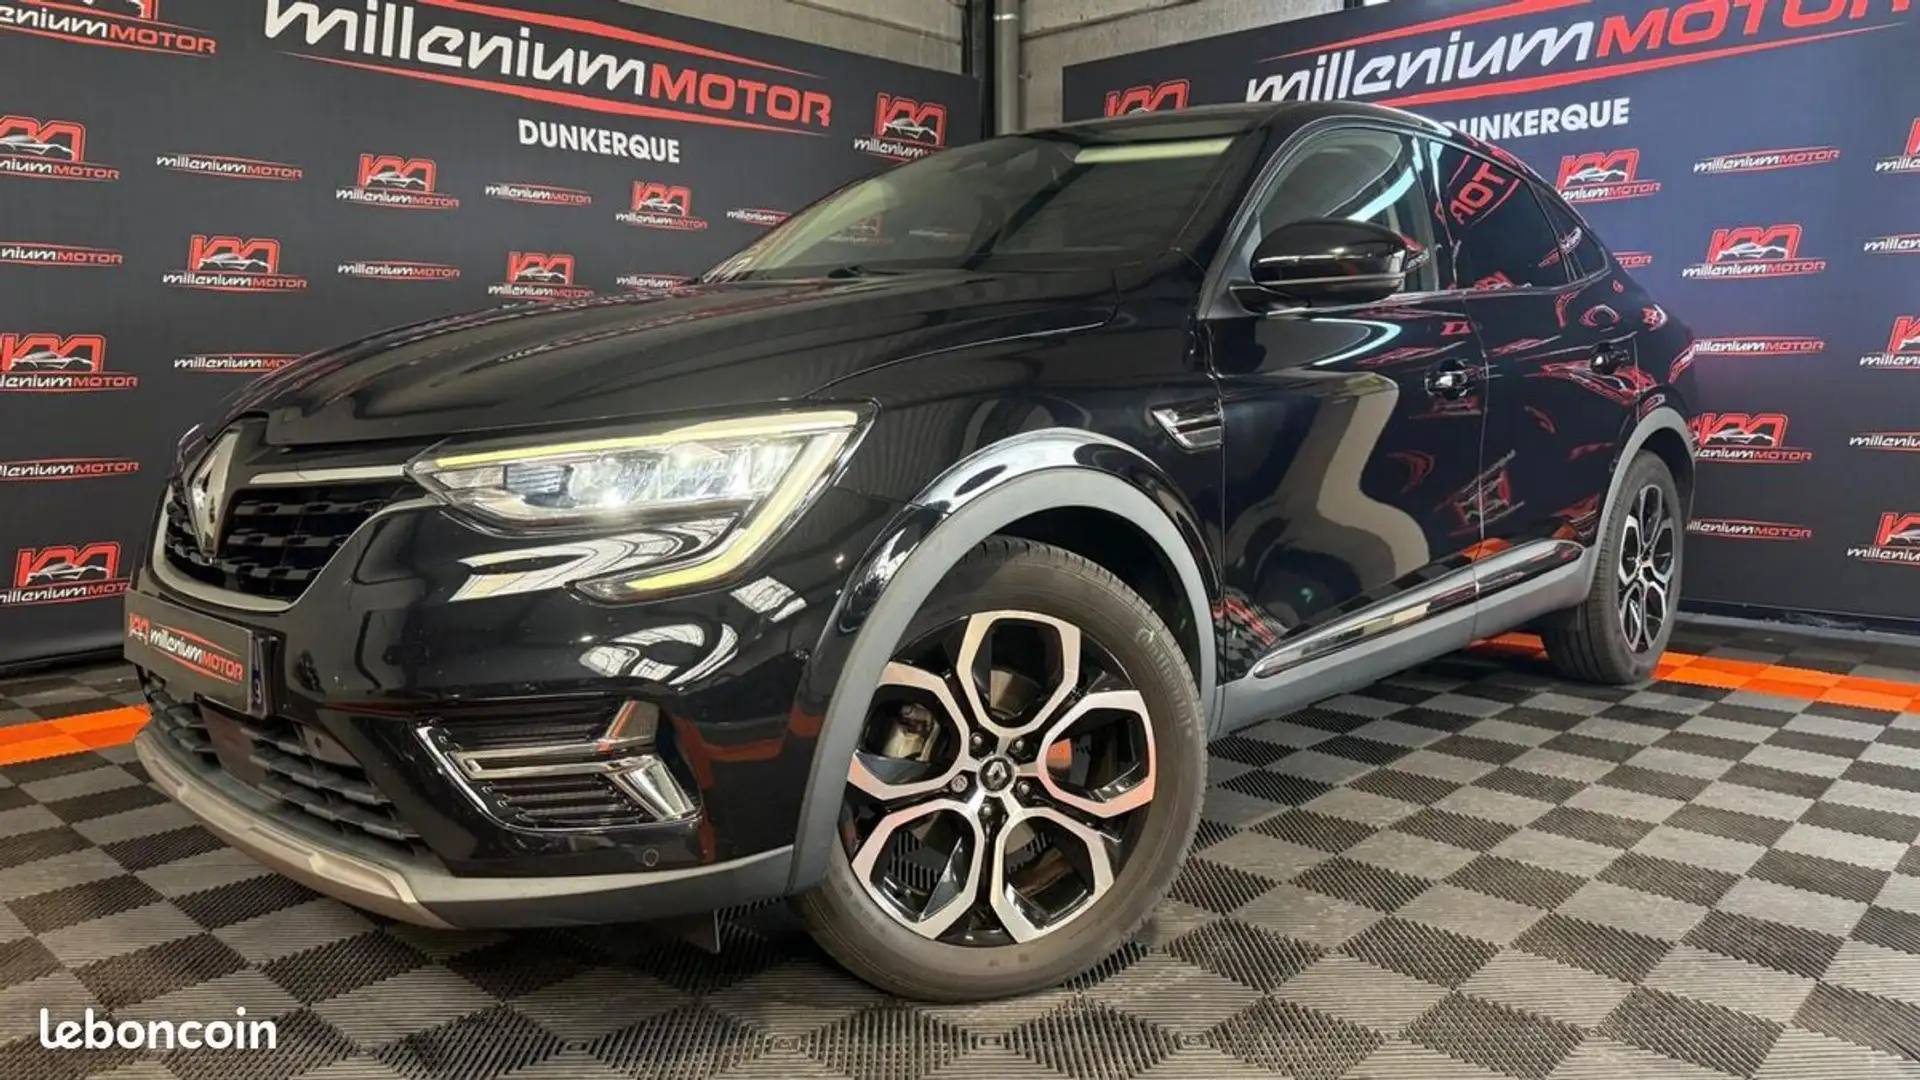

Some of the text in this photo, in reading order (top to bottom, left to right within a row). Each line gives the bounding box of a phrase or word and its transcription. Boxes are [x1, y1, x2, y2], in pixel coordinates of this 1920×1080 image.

[265, 0, 832, 127] milleniumMOTOR
[518, 119, 681, 164] DUNKERQUE
[156, 155, 303, 178] milleniumMOTOR
[1693, 149, 1841, 172] milleniumMOTOR
[335, 188, 460, 208] milleniumMOTOR
[485, 183, 592, 205] milleniumMOTOR
[338, 263, 460, 277] milleniumMOTOR
[1682, 260, 1827, 277] milleniumMOTOR
[163, 273, 307, 288] milleniumMOTOR
[150, 627, 243, 681] milleniumMOTOR
